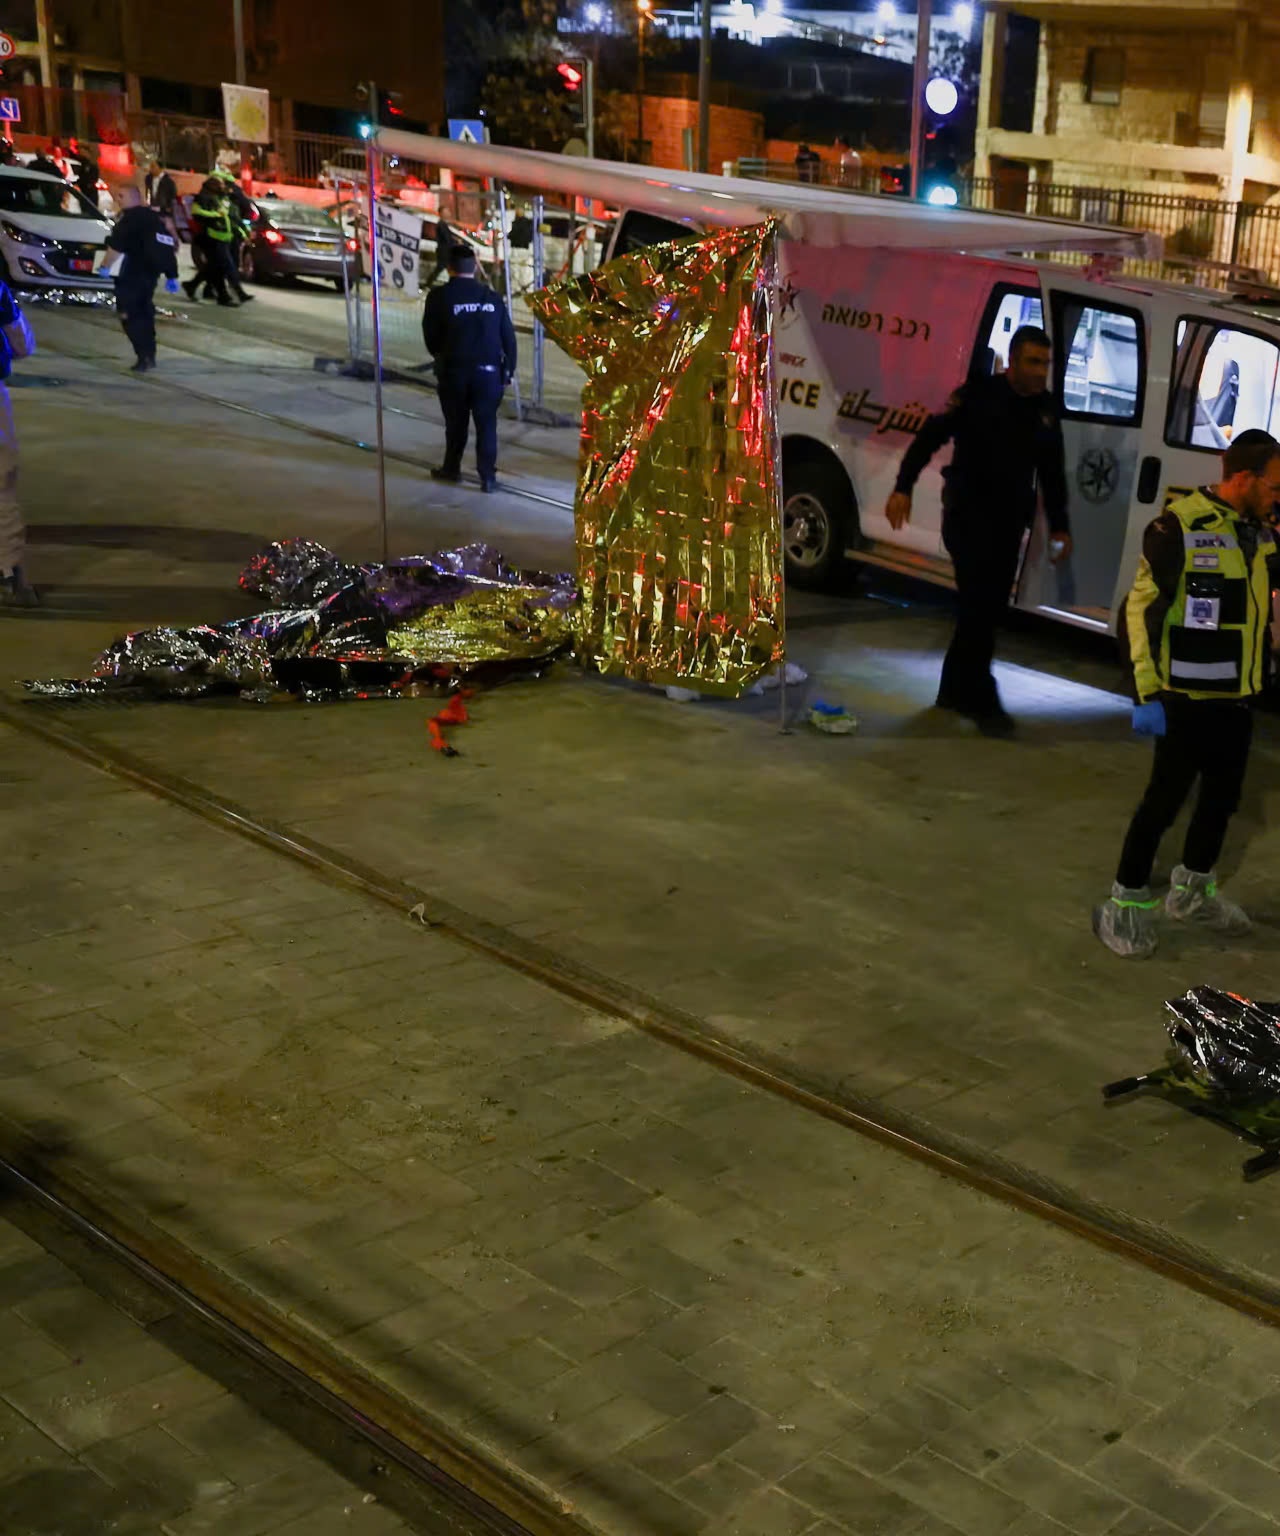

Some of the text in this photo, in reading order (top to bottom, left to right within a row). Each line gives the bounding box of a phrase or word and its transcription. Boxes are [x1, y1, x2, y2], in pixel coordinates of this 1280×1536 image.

[821, 303, 932, 341] רכב רפואה
[780, 377, 821, 409] ICE
